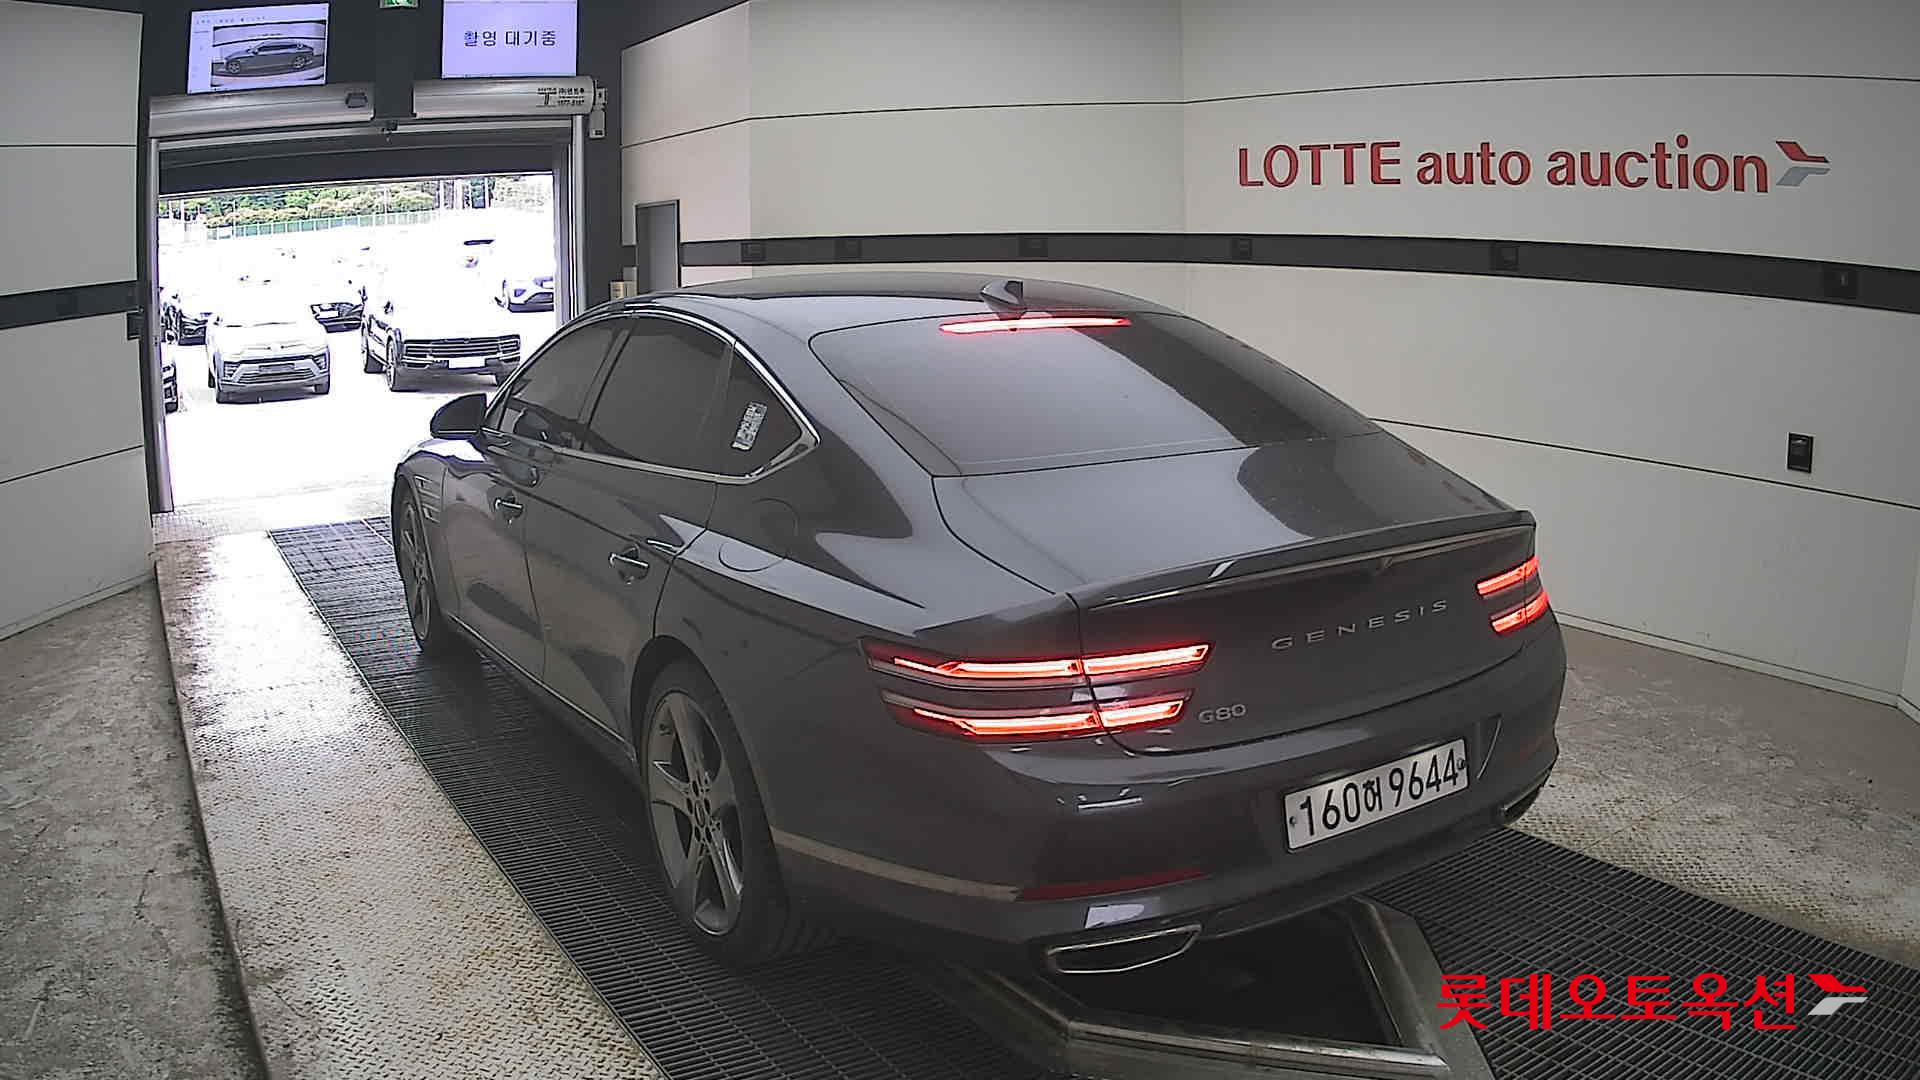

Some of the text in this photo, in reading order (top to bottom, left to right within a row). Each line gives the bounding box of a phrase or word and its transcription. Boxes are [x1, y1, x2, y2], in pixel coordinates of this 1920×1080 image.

[505, 30, 556, 46] 대기중
[1238, 133, 1769, 193] LOTTE auto auction
[1271, 599, 1449, 651] GENESIS
[1198, 703, 1248, 725] G80
